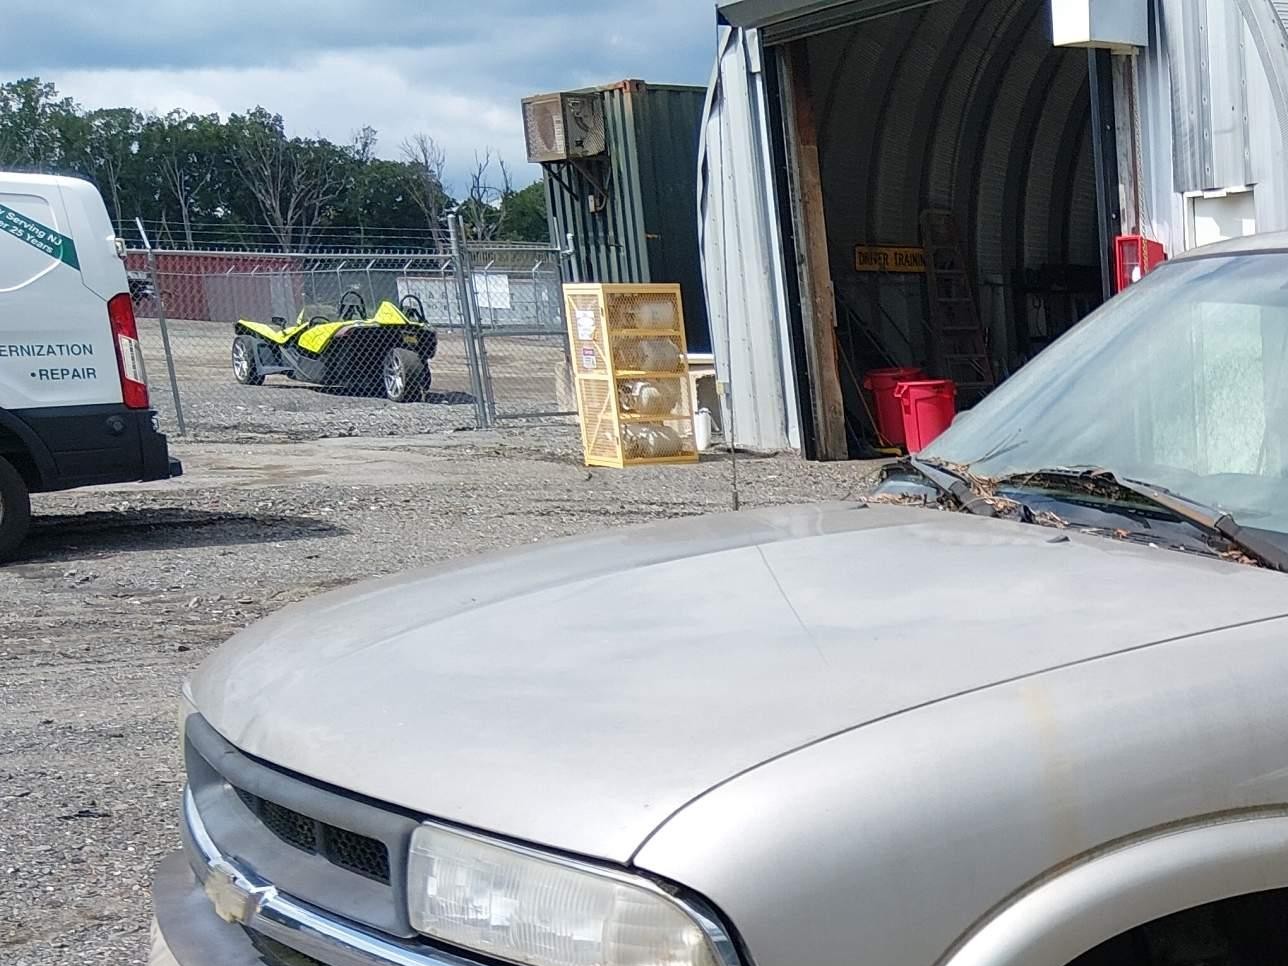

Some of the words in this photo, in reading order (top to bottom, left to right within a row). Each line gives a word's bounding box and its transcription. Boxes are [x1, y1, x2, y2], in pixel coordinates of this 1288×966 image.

[6, 212, 46, 239] Serving
[47, 234, 62, 246] NJ
[10, 226, 25, 237] 25
[26, 233, 54, 254] Years
[858, 251, 889, 266] DRIVER
